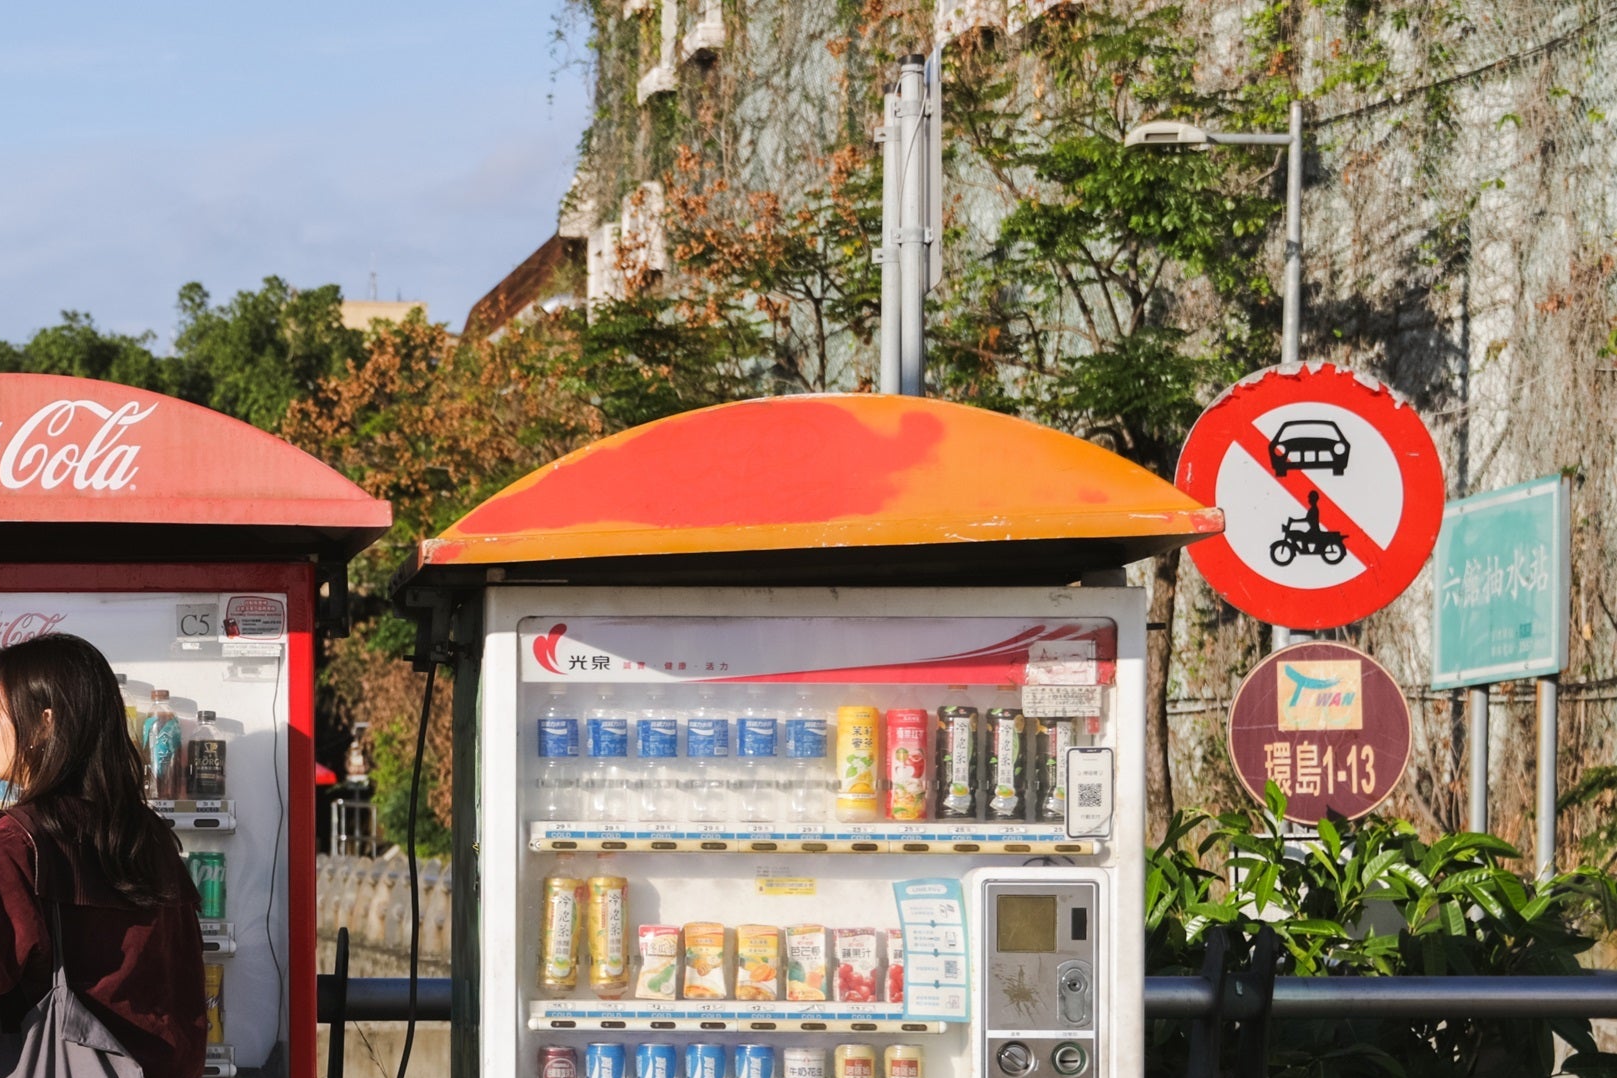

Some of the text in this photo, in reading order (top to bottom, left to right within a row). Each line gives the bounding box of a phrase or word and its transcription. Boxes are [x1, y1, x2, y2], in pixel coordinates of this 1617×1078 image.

[181, 613, 210, 636] C5
[568, 656, 611, 670] 光泉
[1264, 741, 1376, 797] 環島1-13
[841, 948, 871, 959] 蘋果汁
[789, 1067, 823, 1078] 牛奶花生
